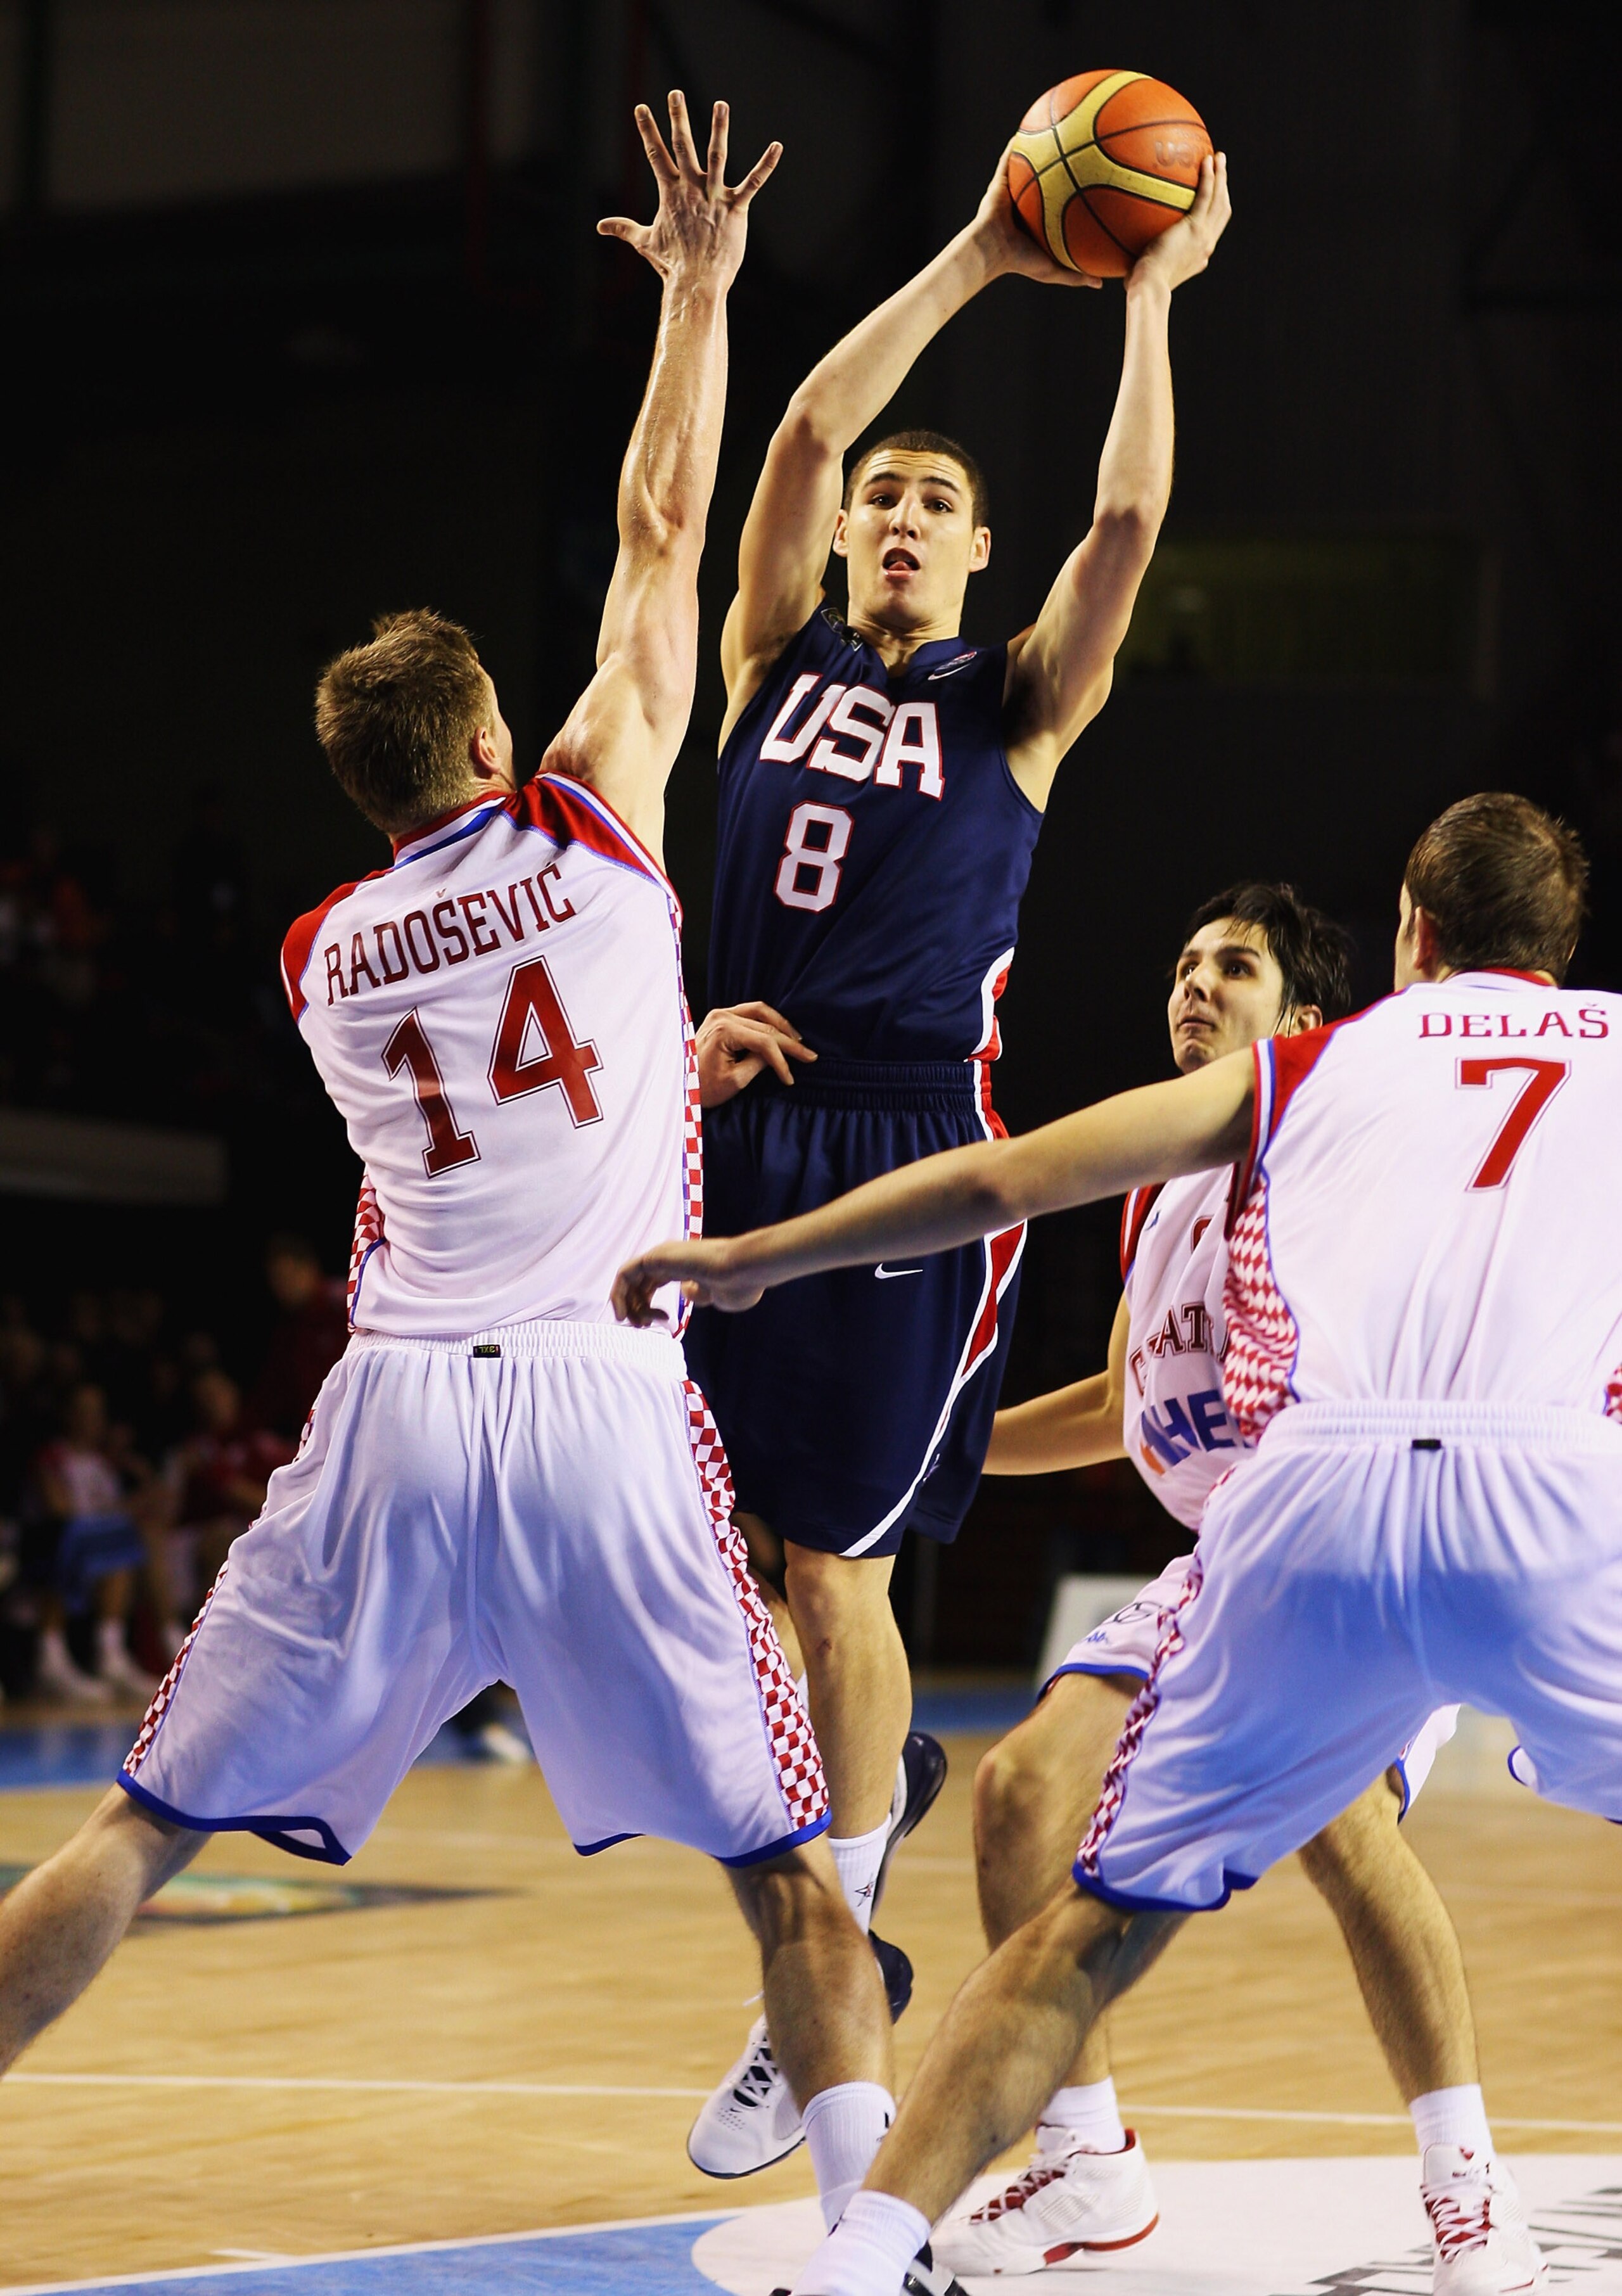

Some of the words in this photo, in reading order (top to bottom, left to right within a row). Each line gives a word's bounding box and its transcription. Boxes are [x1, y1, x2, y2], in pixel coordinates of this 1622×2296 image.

[759, 672, 945, 801] USA
[773, 800, 855, 914] 8
[324, 861, 577, 1006] RADOŠEVIĆ
[381, 955, 604, 1179] 14
[1418, 1002, 1609, 1038] DELAŠ
[1455, 1056, 1572, 1192] 7
